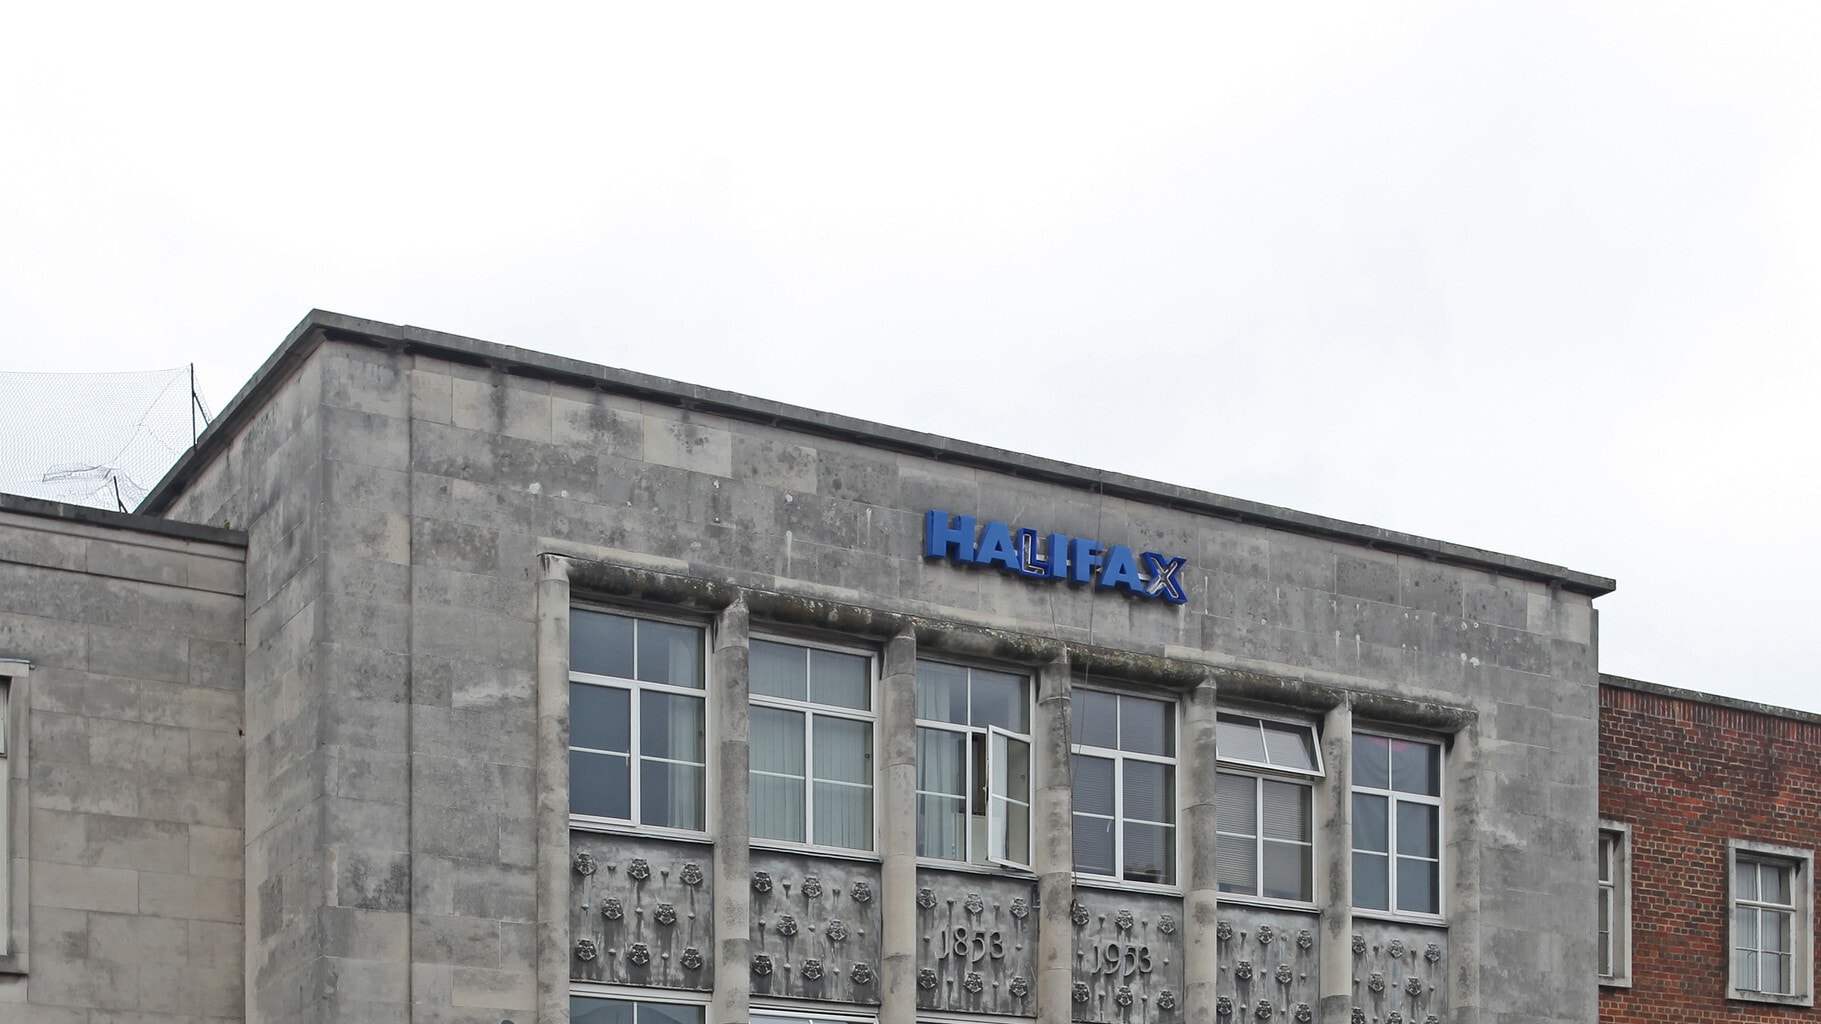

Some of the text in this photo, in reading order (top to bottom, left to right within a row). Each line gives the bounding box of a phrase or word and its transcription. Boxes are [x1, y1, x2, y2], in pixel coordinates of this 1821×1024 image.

[925, 509, 1188, 604] HALIFAX
[939, 923, 1005, 963] 1853
[1091, 942, 1154, 977] 1953
